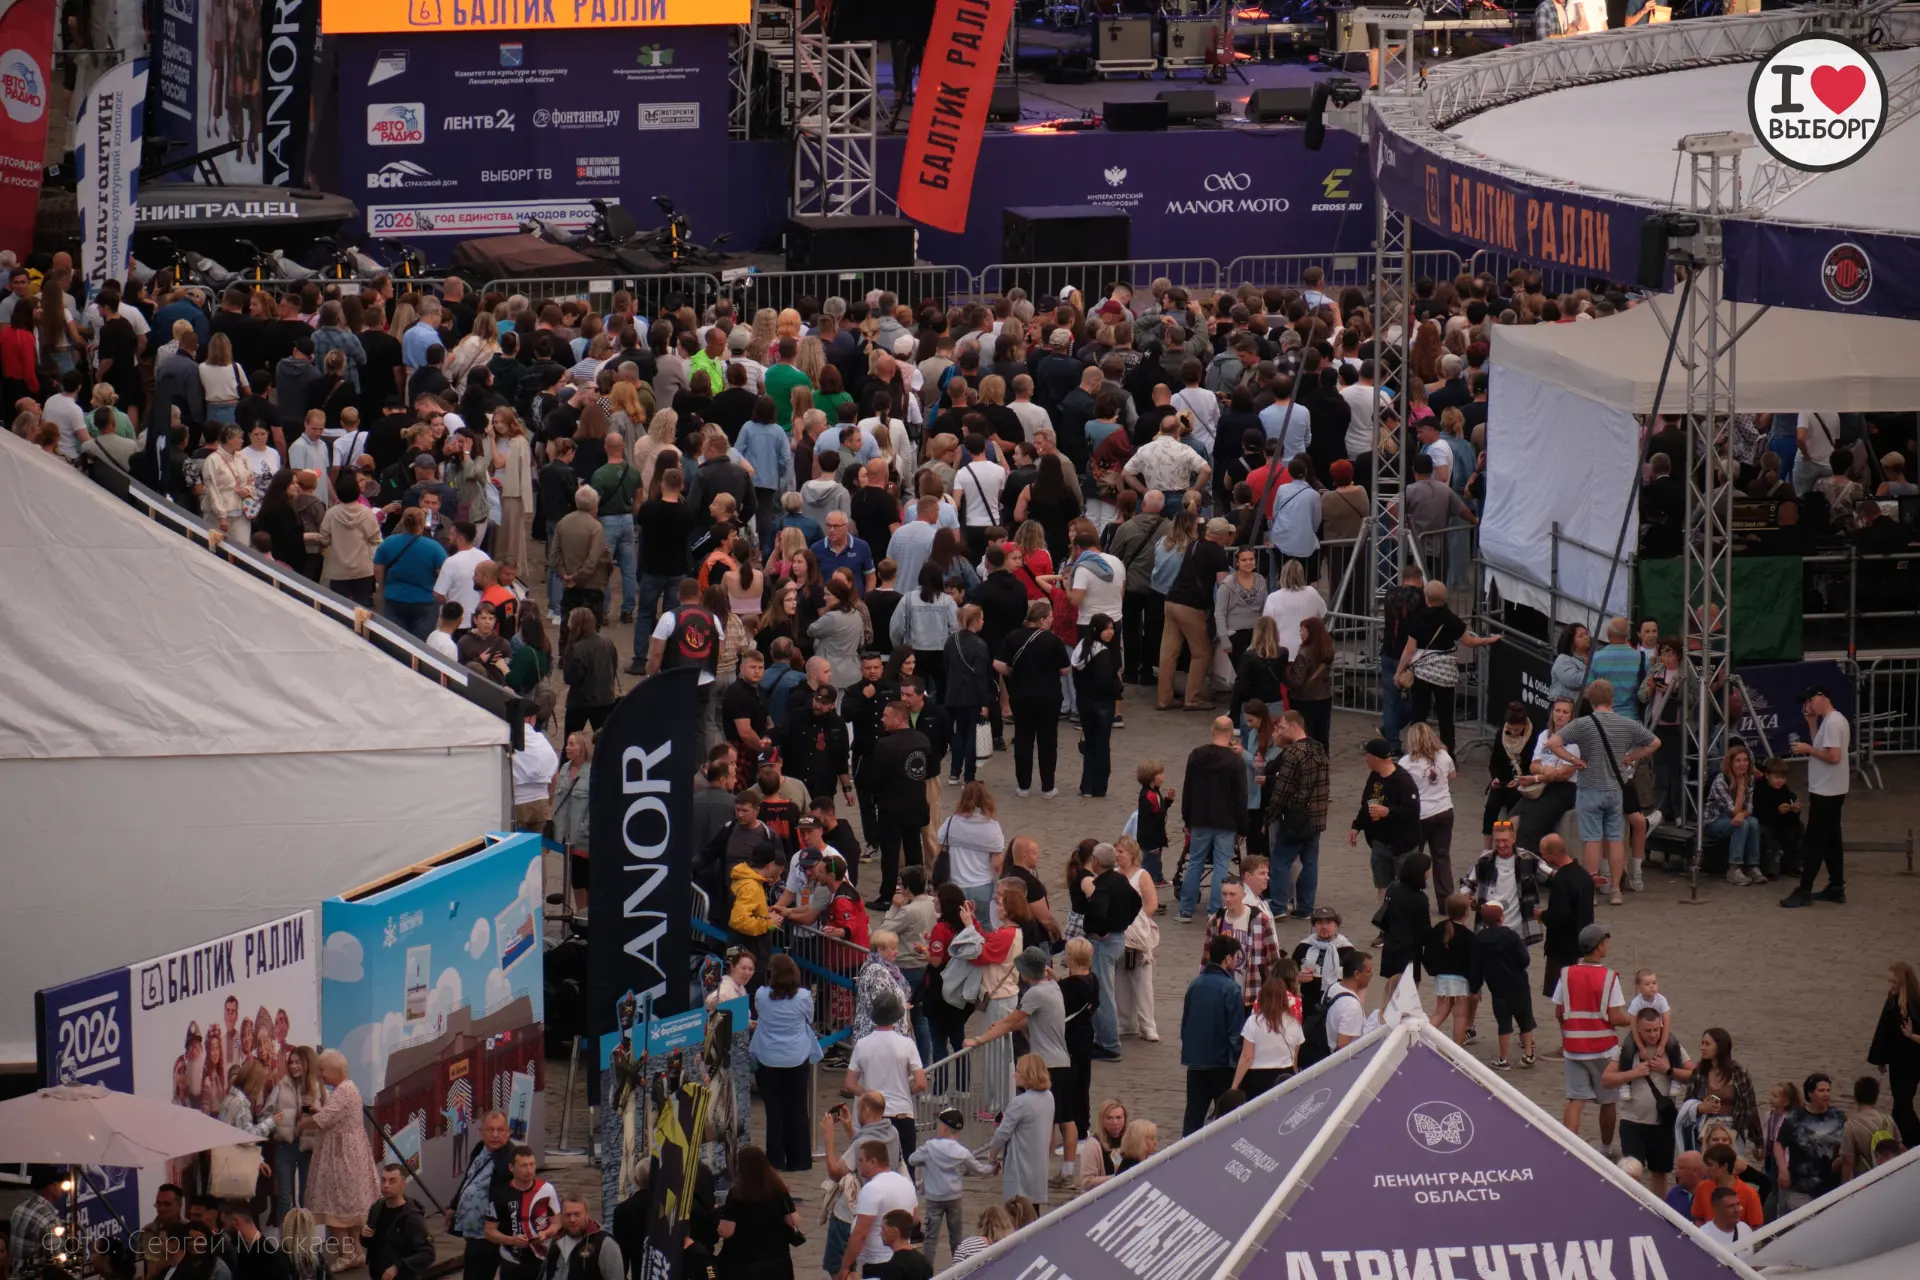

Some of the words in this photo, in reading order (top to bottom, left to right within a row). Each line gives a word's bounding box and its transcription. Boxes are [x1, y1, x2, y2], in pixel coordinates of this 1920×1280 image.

[453, 0, 556, 25] БАЛТИК
[573, 0, 666, 23] РАЛЛИ
[163, 19, 176, 39] ГОД
[163, 39, 192, 67] ЕДИНСТВА
[161, 61, 191, 86] НАРОДОВ
[455, 70, 485, 78] Комитет
[497, 69, 530, 78] культуре
[538, 68, 568, 77] туризму
[468, 77, 524, 85] Ленинградской
[5, 87, 41, 107] РАДИО
[113, 90, 124, 146] комплекс
[372, 121, 405, 132] АВТО
[552, 109, 621, 127] фонтанка.ру
[380, 130, 422, 143] РАДИО
[919, 81, 970, 190] БАЛТИК
[367, 173, 406, 188] ВСК
[405, 179, 441, 187] СТРАХОВОЙ
[442, 179, 458, 187] ДОМ
[481, 169, 534, 182] ВЫБОРГ
[536, 168, 553, 180] ТВ
[1087, 192, 1144, 200] ИМПЕРАТОРСКИЙ
[1165, 199, 1235, 215] MANOR
[1236, 198, 1290, 212] MOTO
[374, 212, 414, 228] 2026
[434, 213, 455, 223] ГОД
[458, 212, 513, 222] ЕДИНСТВА
[516, 210, 567, 220] НАРОДОВ
[1451, 174, 1518, 252] БАЛТИК
[1526, 198, 1611, 272] РАЛЛИ
[168, 940, 235, 1004] БАЛТИК
[245, 916, 305, 978] РАЛЛИ
[59, 1005, 120, 1068] 2026
[1225, 1159, 1253, 1184] ОБЛАСТЬ
[1373, 1168, 1534, 1188] ЛЕНИНГРАДСКАЯ
[1414, 1188, 1501, 1204] ОБЛАСТЬ
